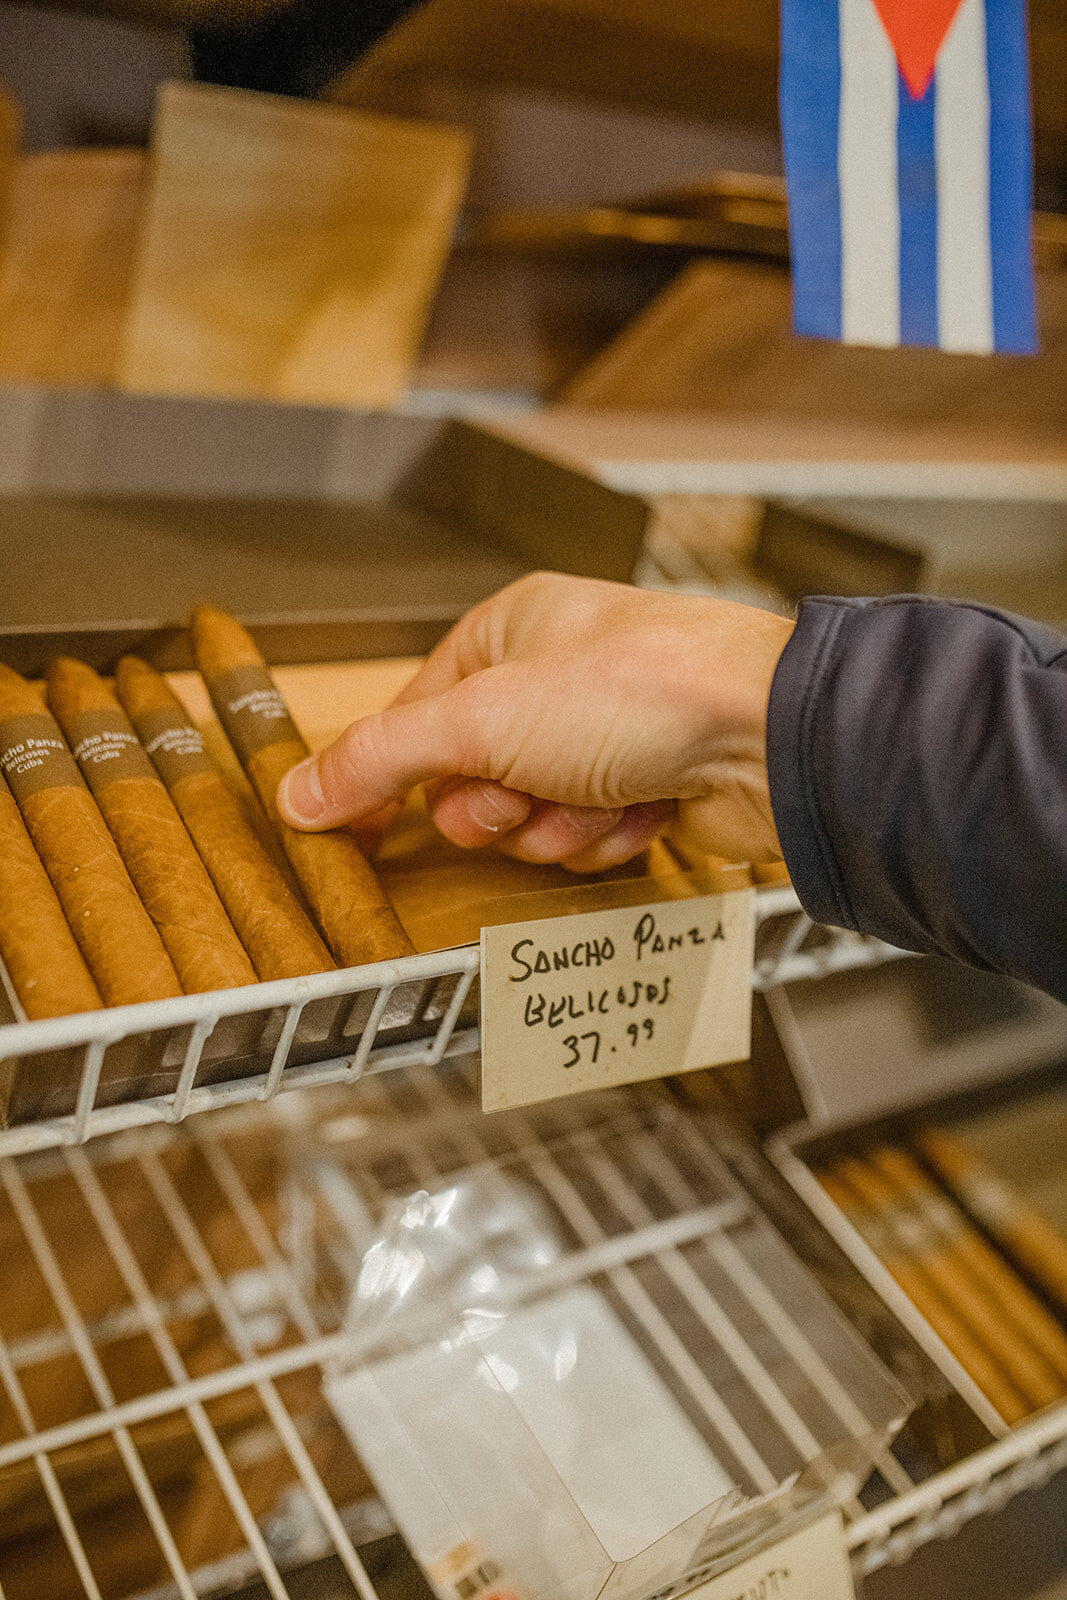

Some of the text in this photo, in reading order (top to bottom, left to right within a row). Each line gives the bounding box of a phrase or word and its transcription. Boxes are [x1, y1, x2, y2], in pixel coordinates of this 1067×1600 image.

[0, 738, 65, 767] ncho Panza
[16, 758, 44, 774] Cuba
[509, 913, 725, 982] SANCHO PANZA
[524, 976, 672, 1028] BELICOSOS
[562, 1018, 654, 1068] 37.99
